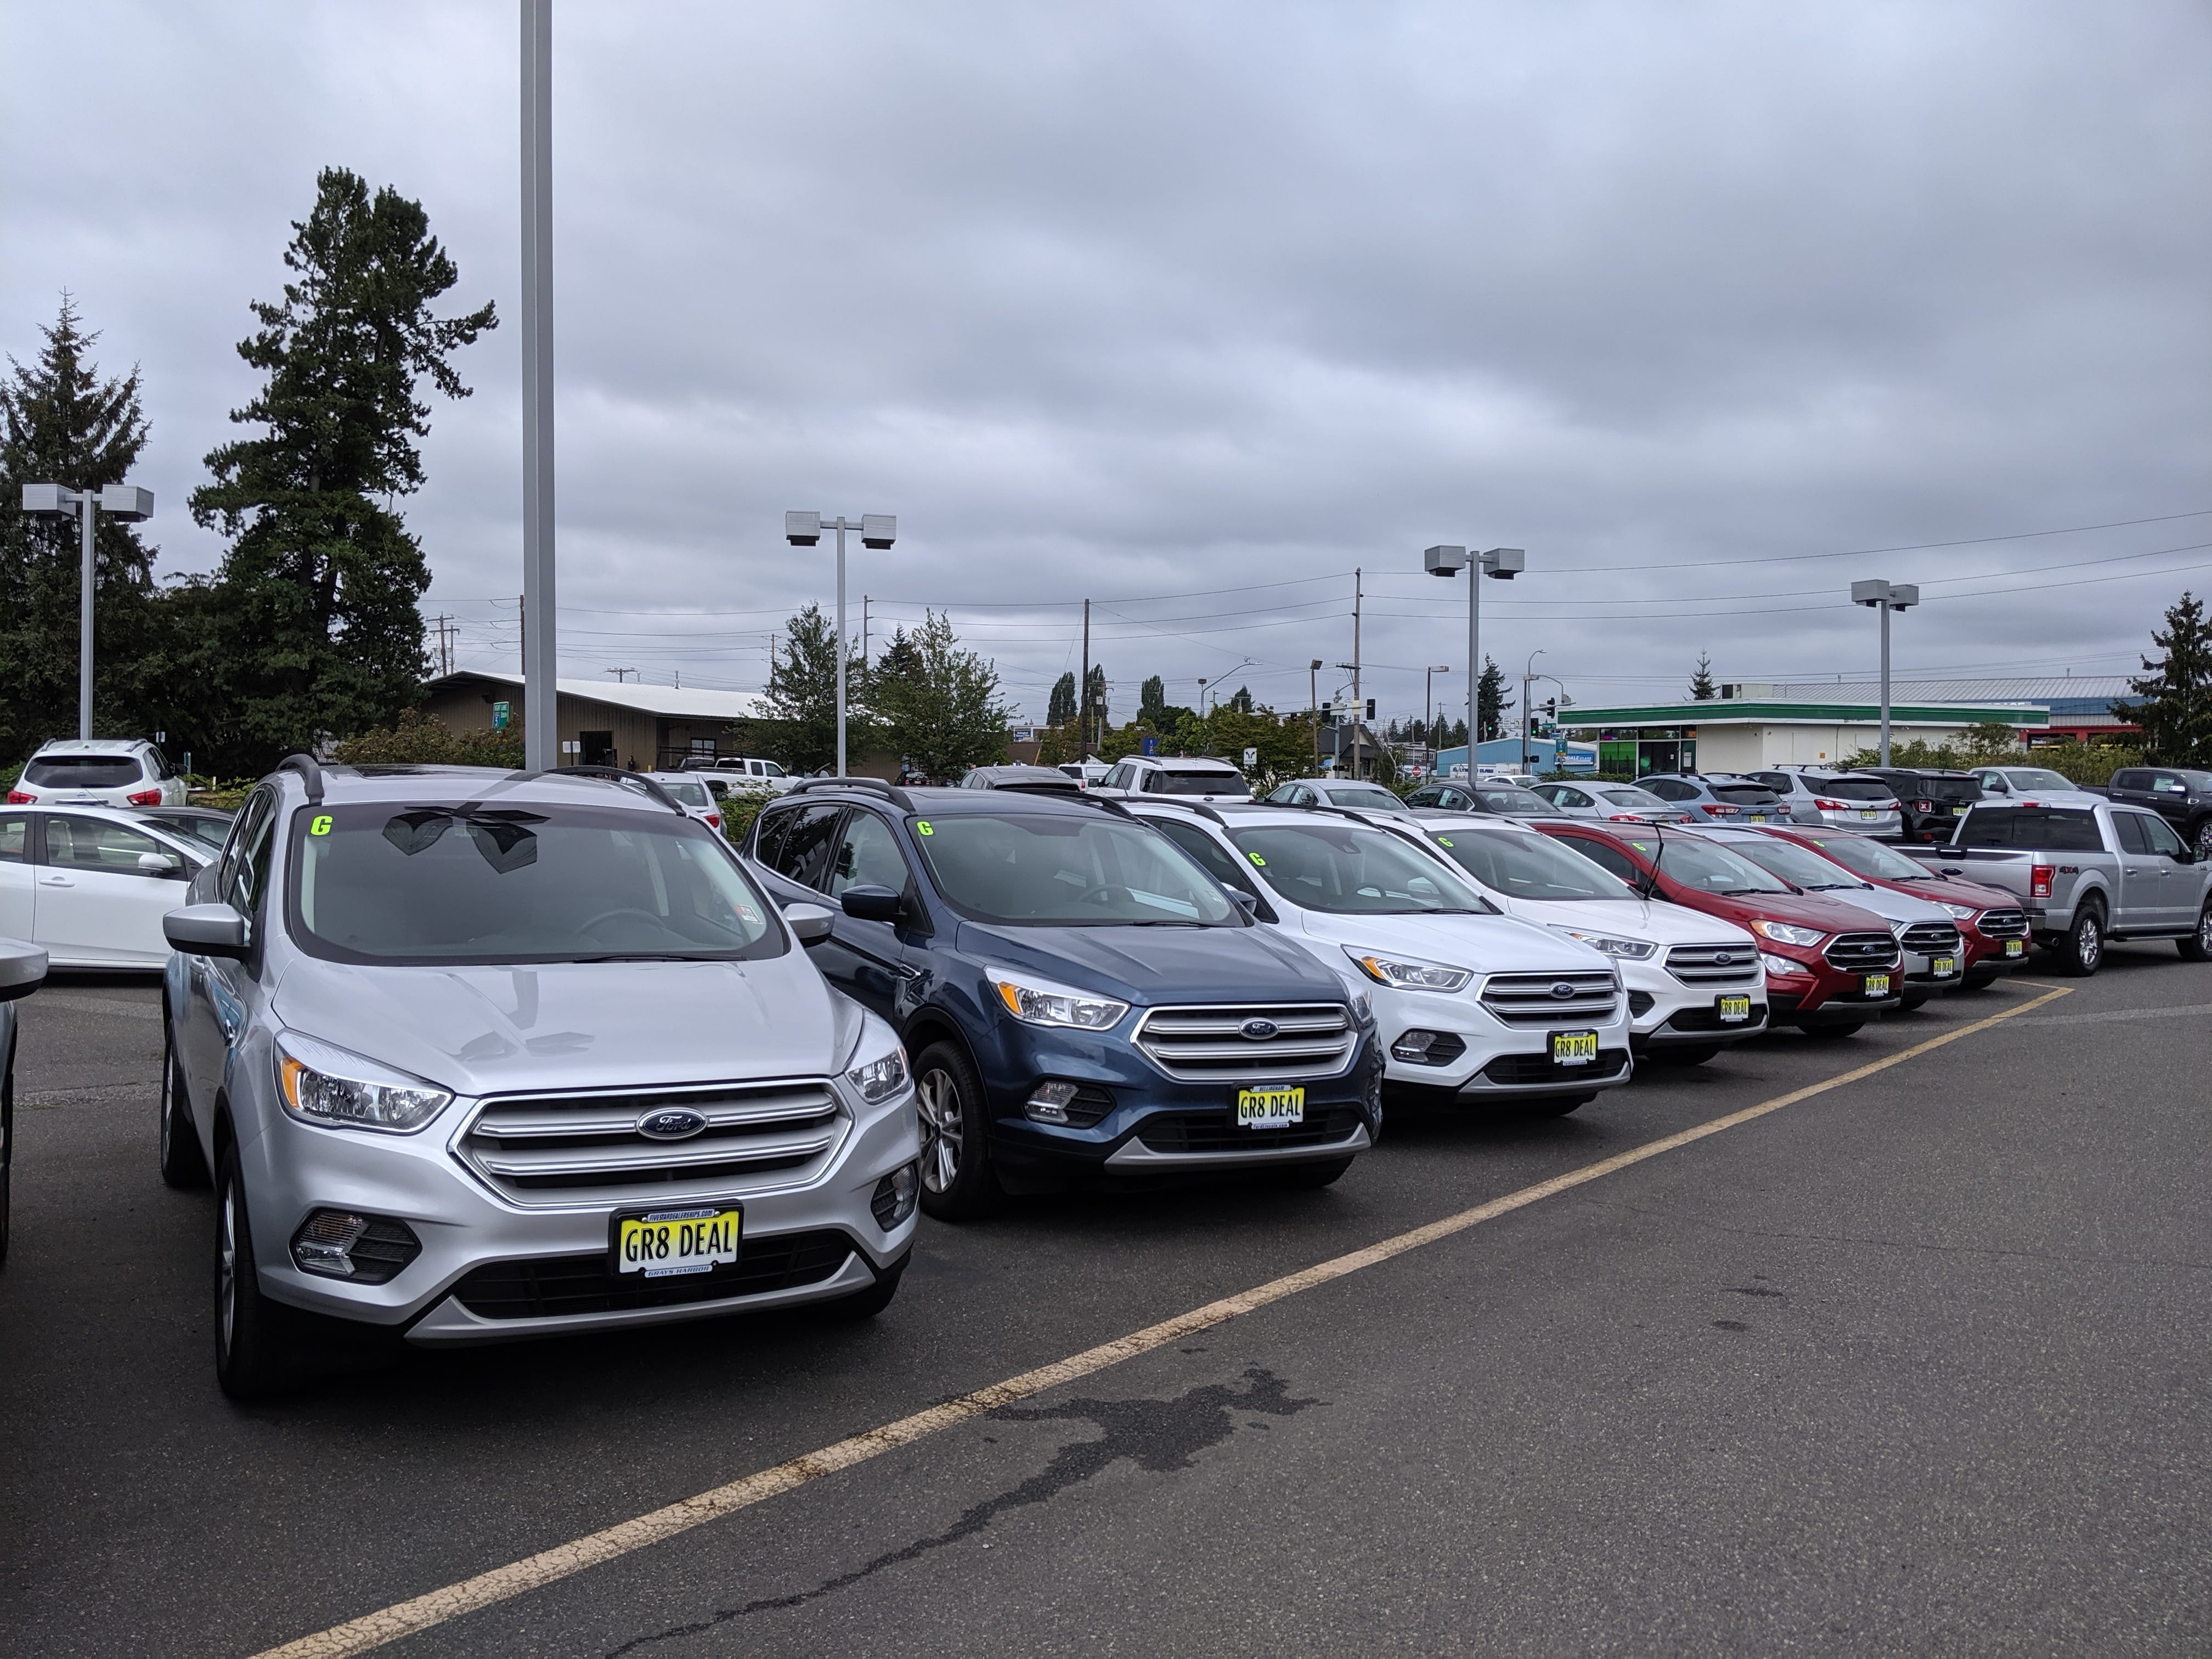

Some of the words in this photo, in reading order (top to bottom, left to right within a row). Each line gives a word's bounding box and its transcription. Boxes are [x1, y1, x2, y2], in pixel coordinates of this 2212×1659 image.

[495, 716, 498, 726] 5
[311, 816, 332, 835] G
[917, 821, 934, 835] G
[1249, 853, 1266, 866] G
[1943, 961, 1951, 972] DEAL
[1866, 979, 1875, 991] GR8
[1876, 979, 1887, 991] DEAL
[1722, 1002, 1732, 1015] GR8
[1734, 1001, 1747, 1014] DEAL
[1250, 1023, 1271, 1034] Ford
[1555, 1040, 1571, 1058] GR8
[1574, 1039, 1594, 1056] DEAL
[1240, 1096, 1265, 1119] GR8
[1270, 1094, 1300, 1117] DEAL
[656, 1115, 692, 1132] Ford
[650, 1210, 713, 1221] FIVESTARDEALERSHIPS.COM
[625, 1226, 670, 1263] GR8
[679, 1221, 733, 1258] DEAL
[675, 1266, 710, 1274] HARBOR
